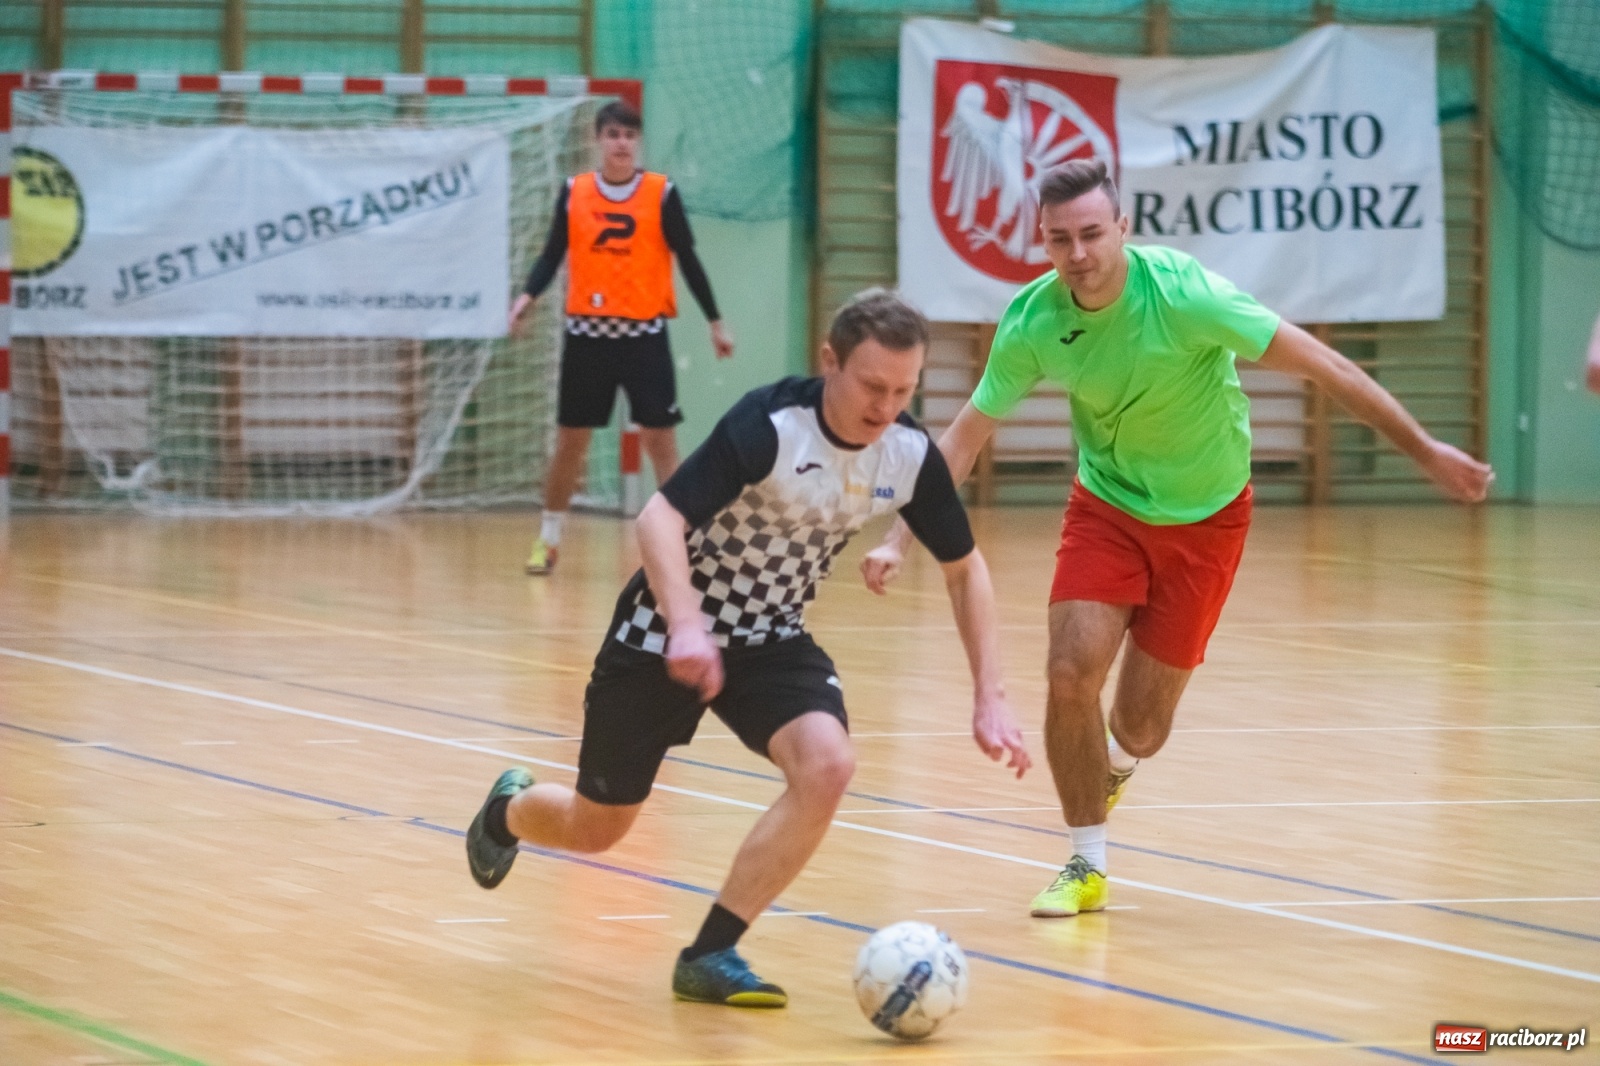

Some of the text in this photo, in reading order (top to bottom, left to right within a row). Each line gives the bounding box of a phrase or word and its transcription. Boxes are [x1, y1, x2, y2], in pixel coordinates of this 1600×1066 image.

[1172, 111, 1384, 166] MIASTO
[112, 160, 476, 301] JEST W PORZĄDKU!
[1131, 170, 1422, 237] RACIBÓRZ
